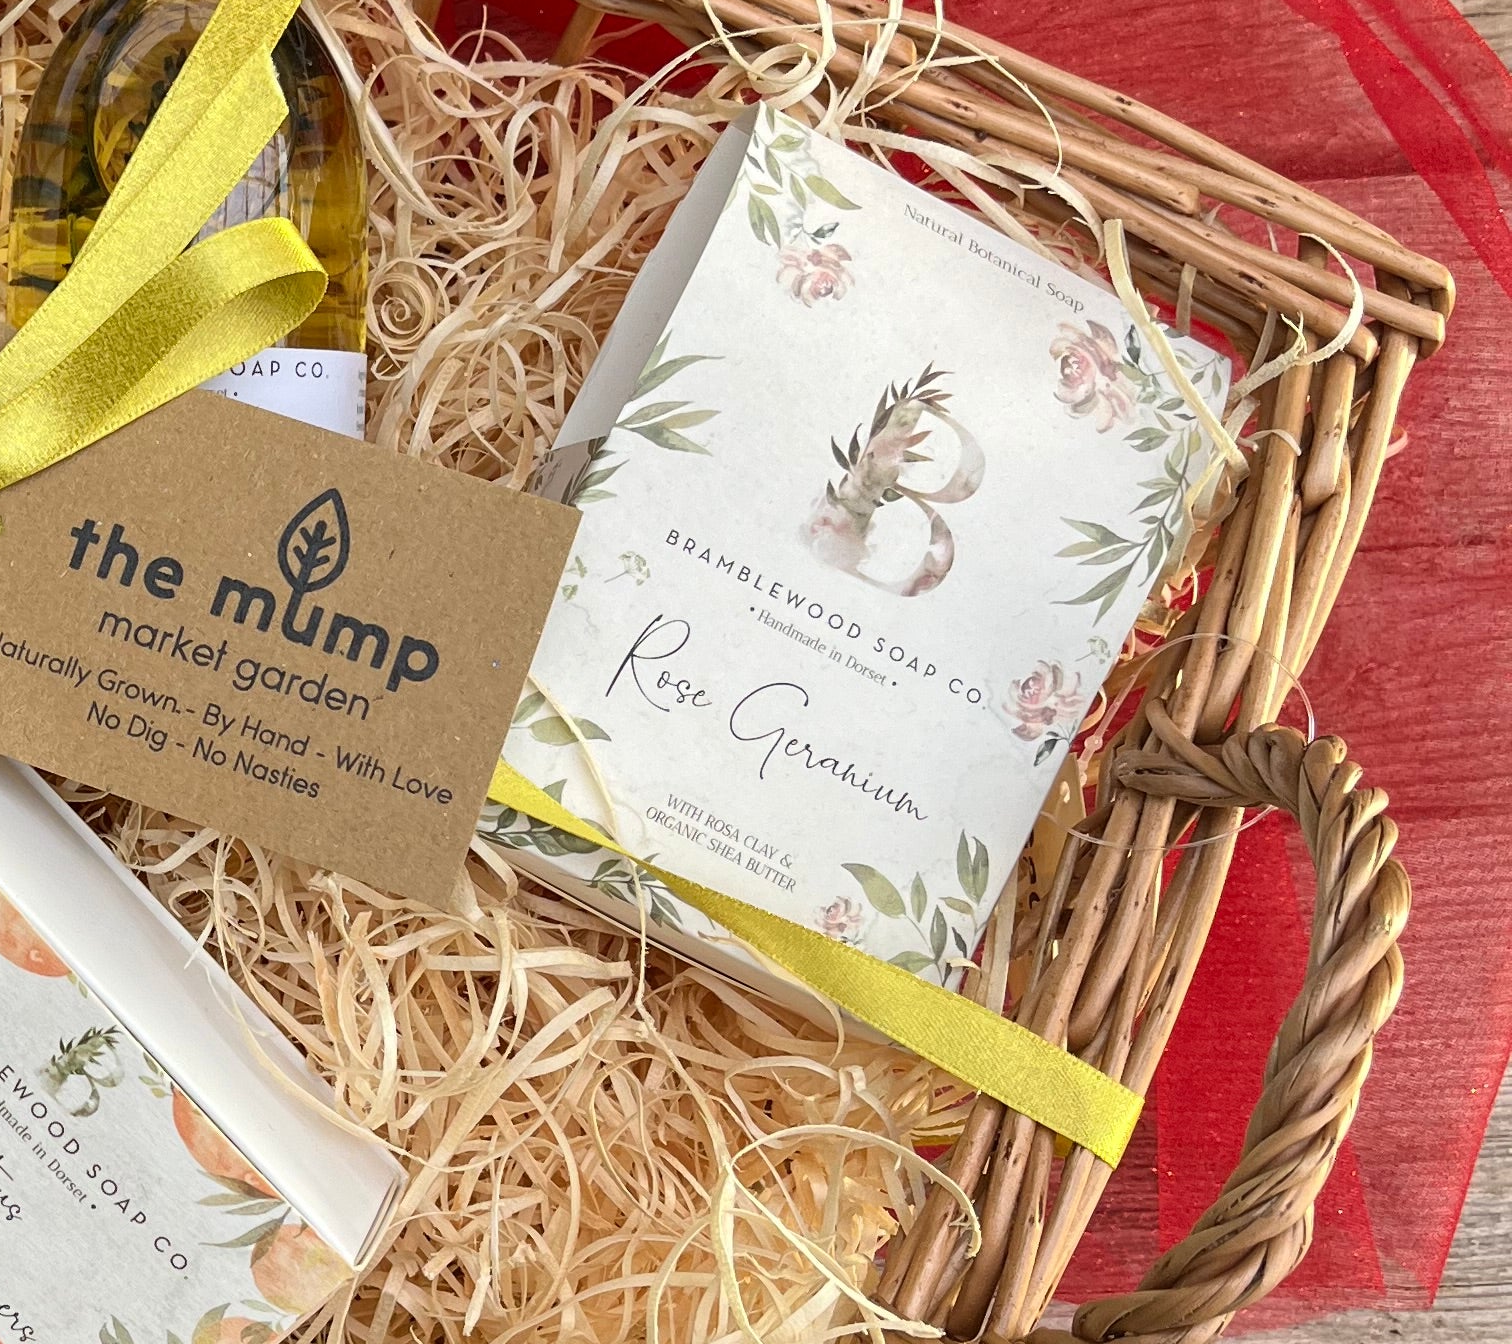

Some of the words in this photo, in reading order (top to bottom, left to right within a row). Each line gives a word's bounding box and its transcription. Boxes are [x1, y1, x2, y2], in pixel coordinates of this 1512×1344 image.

[904, 203, 963, 246] Natural
[968, 239, 1041, 289] Botanical
[1047, 282, 1085, 314] Soap
[230, 360, 281, 376] OAP
[295, 361, 329, 379] CO.
[69, 518, 185, 600] the
[209, 571, 442, 692] mump
[665, 528, 862, 639] BRAMBLEWOOD
[873, 637, 938, 678] SOAP
[948, 677, 986, 711] CO.
[757, 609, 827, 654] Handmade
[828, 645, 843, 662] in
[845, 654, 888, 687] Dorset
[97, 609, 228, 672] market
[232, 656, 372, 721] garden
[86, 700, 121, 730] No
[127, 714, 168, 752] Dig
[192, 736, 227, 767] No
[233, 753, 321, 799] Nasties
[202, 703, 236, 736] By
[240, 714, 312, 757] Hand
[336, 746, 387, 785] With
[392, 761, 455, 805] Love
[605, 614, 713, 713] Rose
[729, 682, 929, 822] Geranium
[646, 806, 707, 846] ORGANIC
[707, 838, 741, 865] SHEA
[745, 857, 797, 893] BUTTER
[667, 793, 705, 822] WITH
[705, 814, 740, 842] ROSA
[743, 835, 779, 860] CLAY
[779, 853, 793, 869] &
[32, 1142, 47, 1160] in
[47, 1159, 87, 1203] Dorset
[86, 1164, 147, 1225] SOAP
[153, 1236, 189, 1280] CO.
